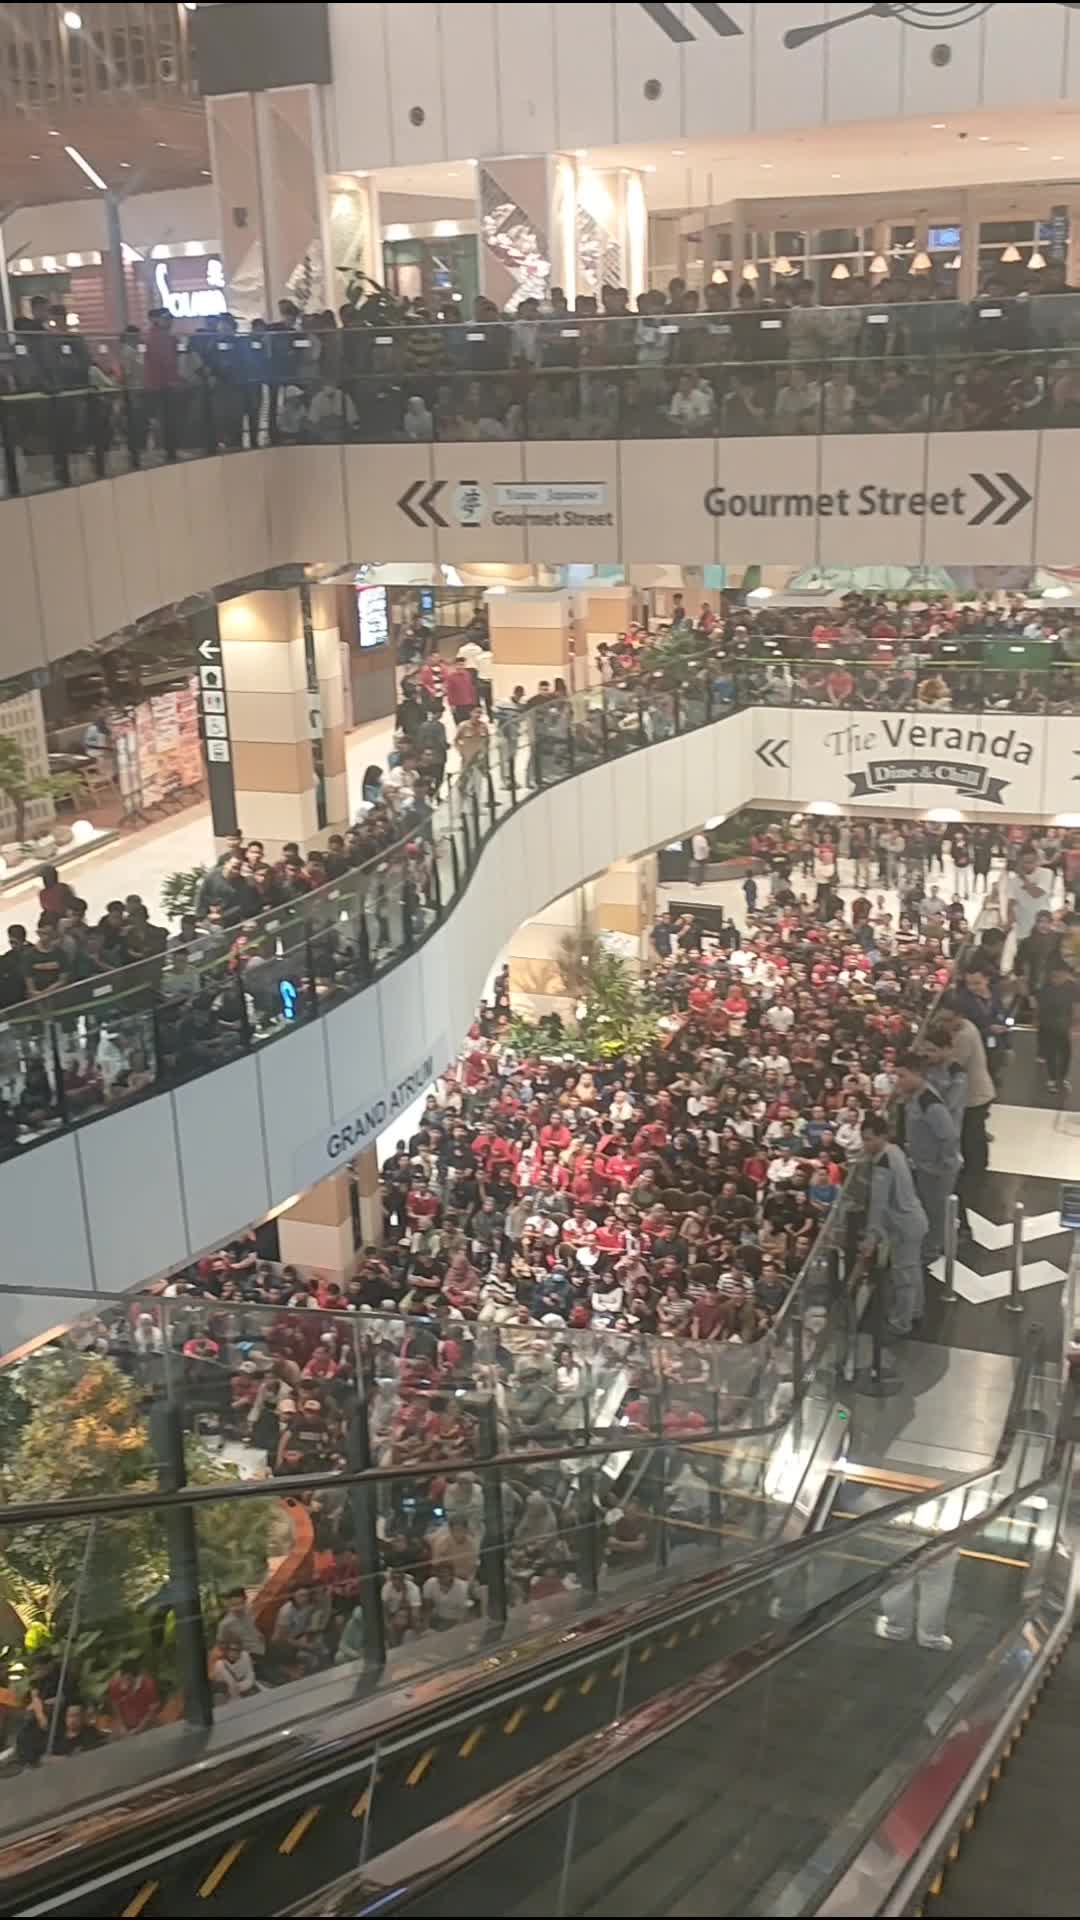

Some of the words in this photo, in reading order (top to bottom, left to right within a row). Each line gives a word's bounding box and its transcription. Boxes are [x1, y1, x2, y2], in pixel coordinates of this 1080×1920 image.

[492, 511, 560, 526] Gourmet
[563, 511, 613, 526] Street
[703, 486, 851, 518] Gourmet
[857, 484, 967, 516] Street
[823, 724, 878, 757] The
[881, 718, 1034, 765] Veranda
[326, 1100, 387, 1159] GRAND
[389, 1055, 433, 1115] ATRIUM
